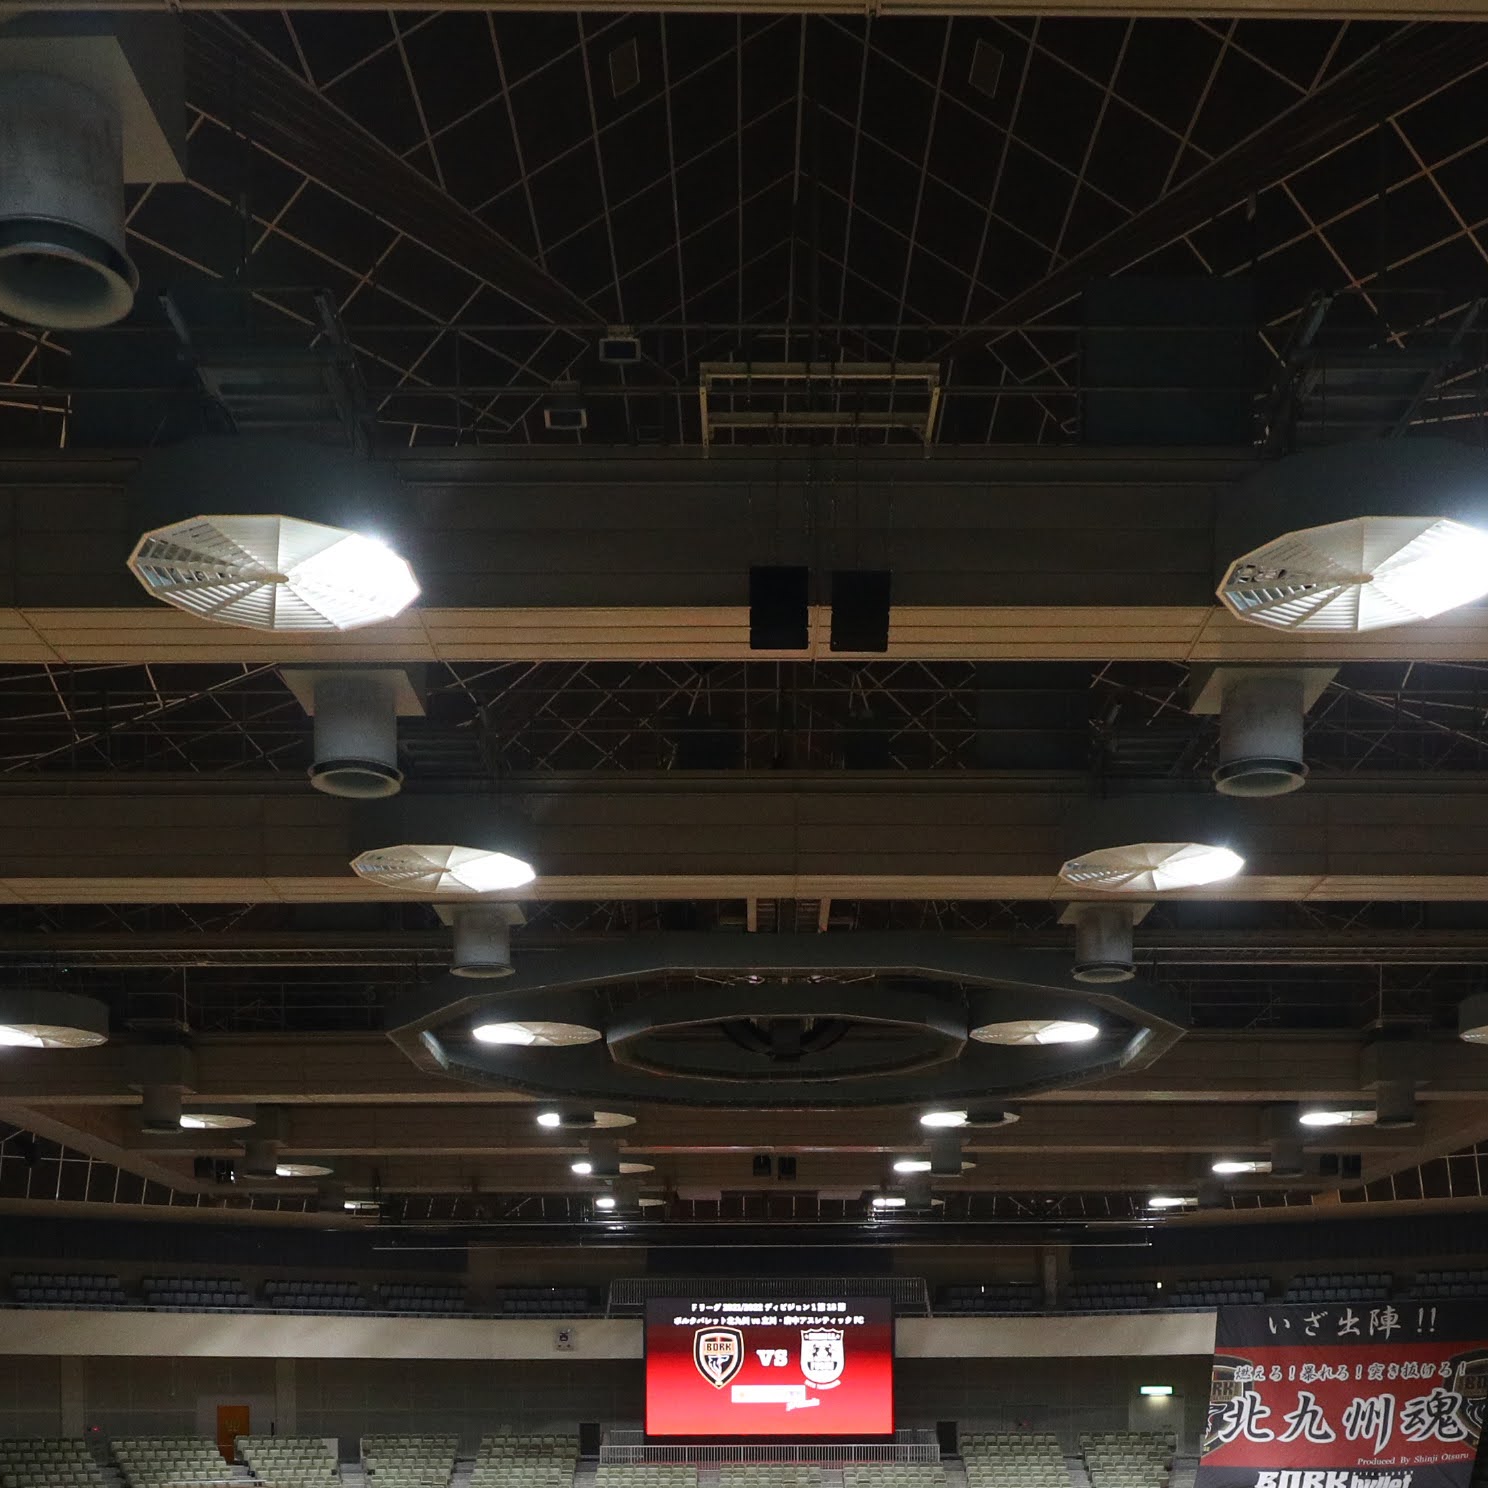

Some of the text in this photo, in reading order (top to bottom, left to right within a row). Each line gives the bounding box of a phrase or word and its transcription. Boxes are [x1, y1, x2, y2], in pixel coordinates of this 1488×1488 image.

[707, 1342, 732, 1352] BORK
[1218, 1388, 1468, 1456] 北九州魂
[1357, 1452, 1469, 1466] Produced By Shinji Otsuru
